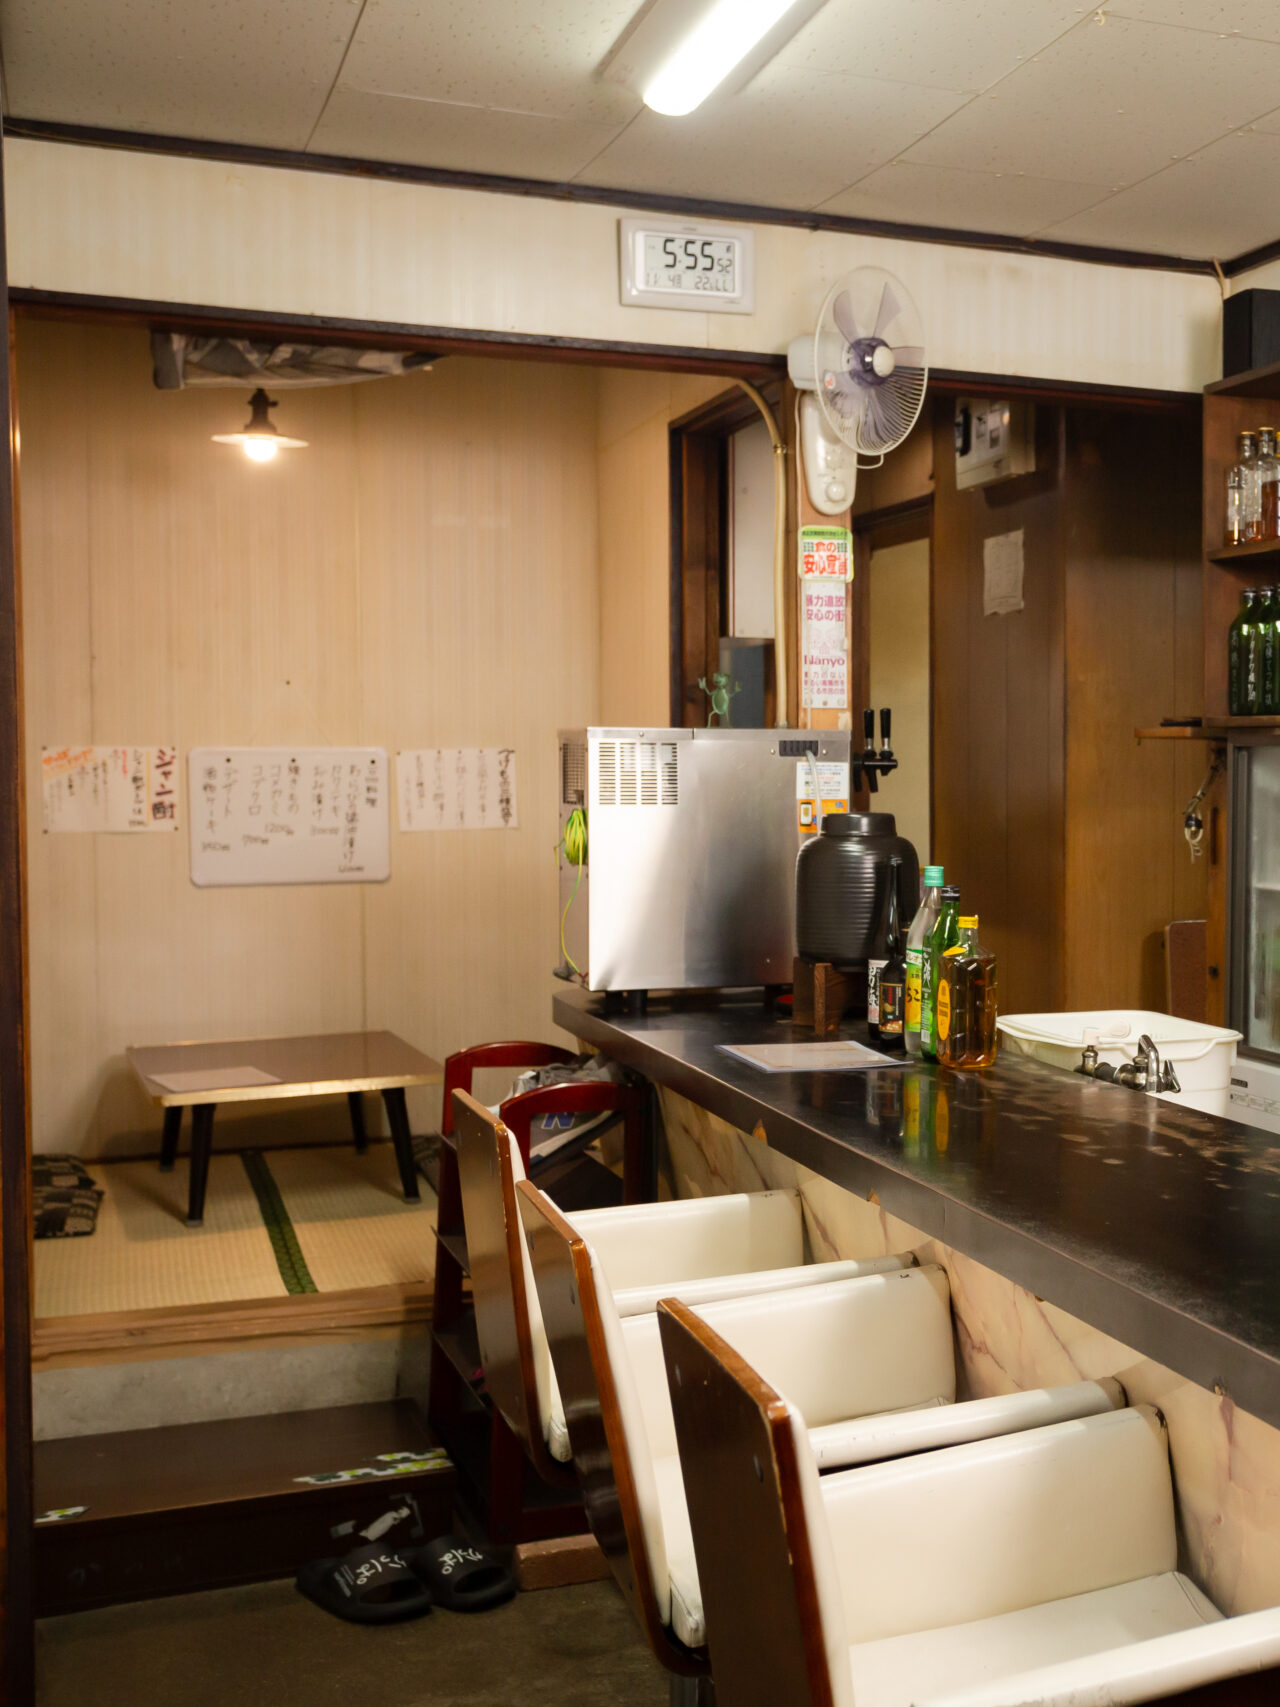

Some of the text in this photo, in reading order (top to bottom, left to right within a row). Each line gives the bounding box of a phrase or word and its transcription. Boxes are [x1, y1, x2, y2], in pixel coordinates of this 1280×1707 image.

[663, 238, 715, 272] 5:55
[803, 554, 848, 575] 安心宣言
[804, 655, 845, 668] Nanyo
